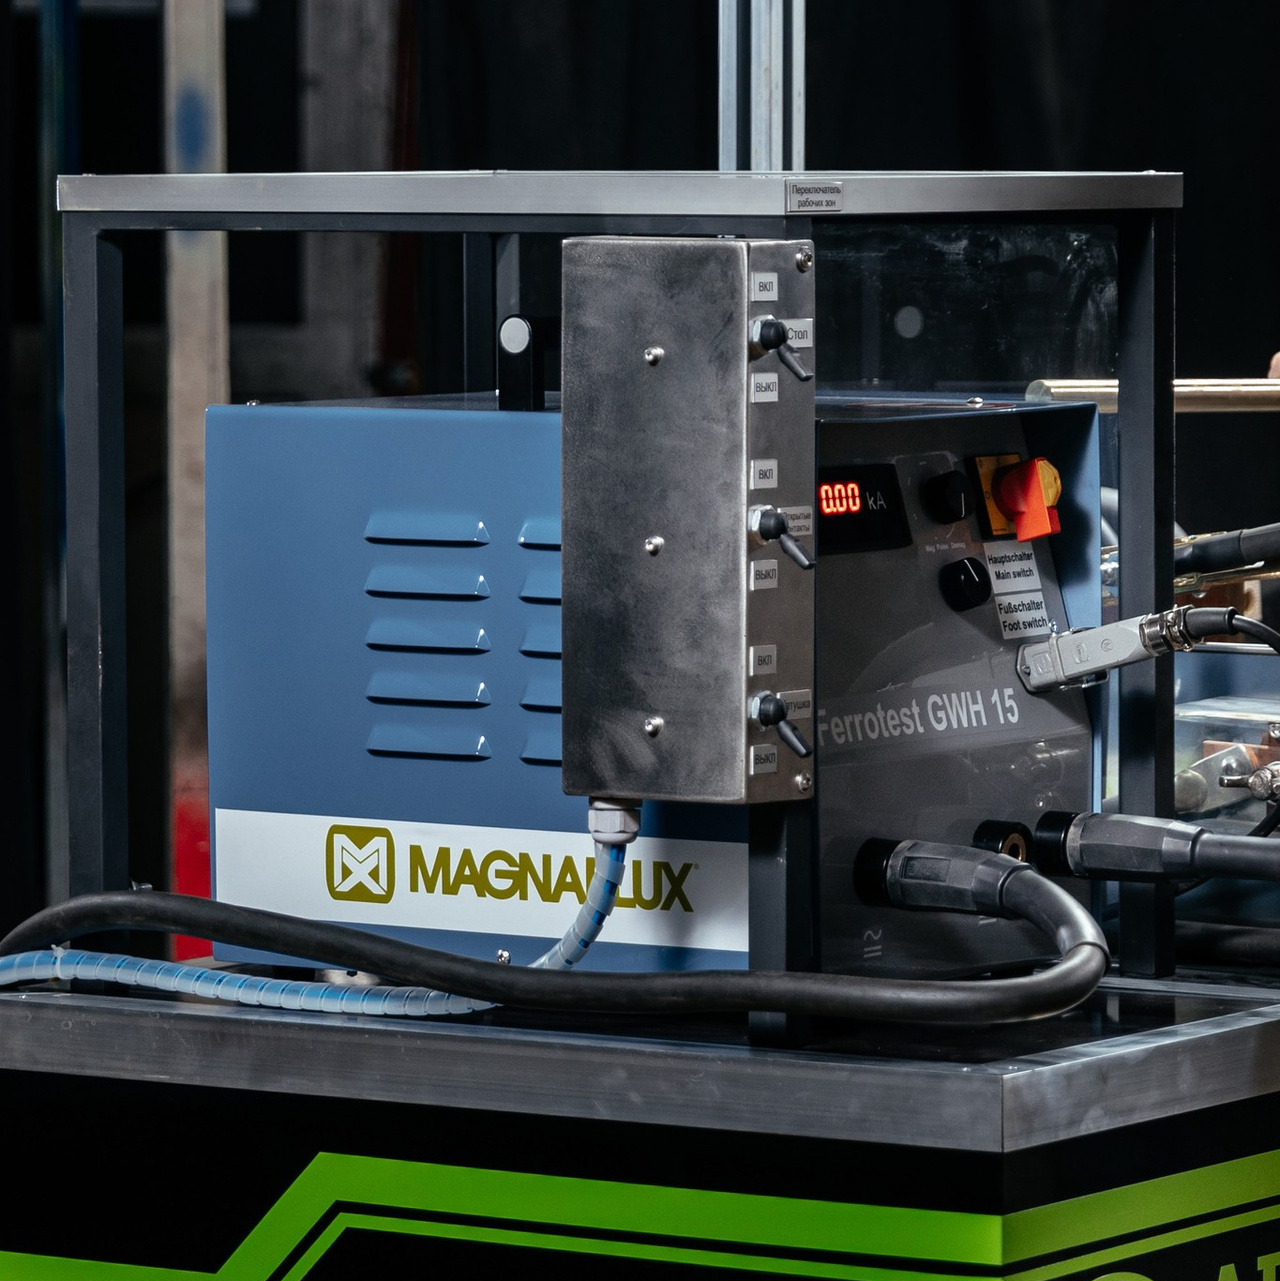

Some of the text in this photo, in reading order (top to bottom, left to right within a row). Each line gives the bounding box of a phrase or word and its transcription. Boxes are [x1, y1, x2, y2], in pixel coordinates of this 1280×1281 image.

[759, 281, 774, 292] ВКЛ
[787, 327, 808, 340] Стол
[755, 381, 777, 392] ВЫКЛ
[759, 468, 774, 480] ВКЛ
[866, 491, 887, 510] kA
[988, 551, 1033, 565] Hauptschalter
[755, 568, 777, 580] ВЫКЛ
[995, 567, 1034, 580] Main switch
[998, 600, 1044, 615] Fußschalter
[1003, 616, 1048, 632] Foot switch
[757, 655, 773, 666] ВКЛ
[817, 687, 1020, 746] Ferrotest GWH 15
[754, 752, 776, 765] ВЫКЛ
